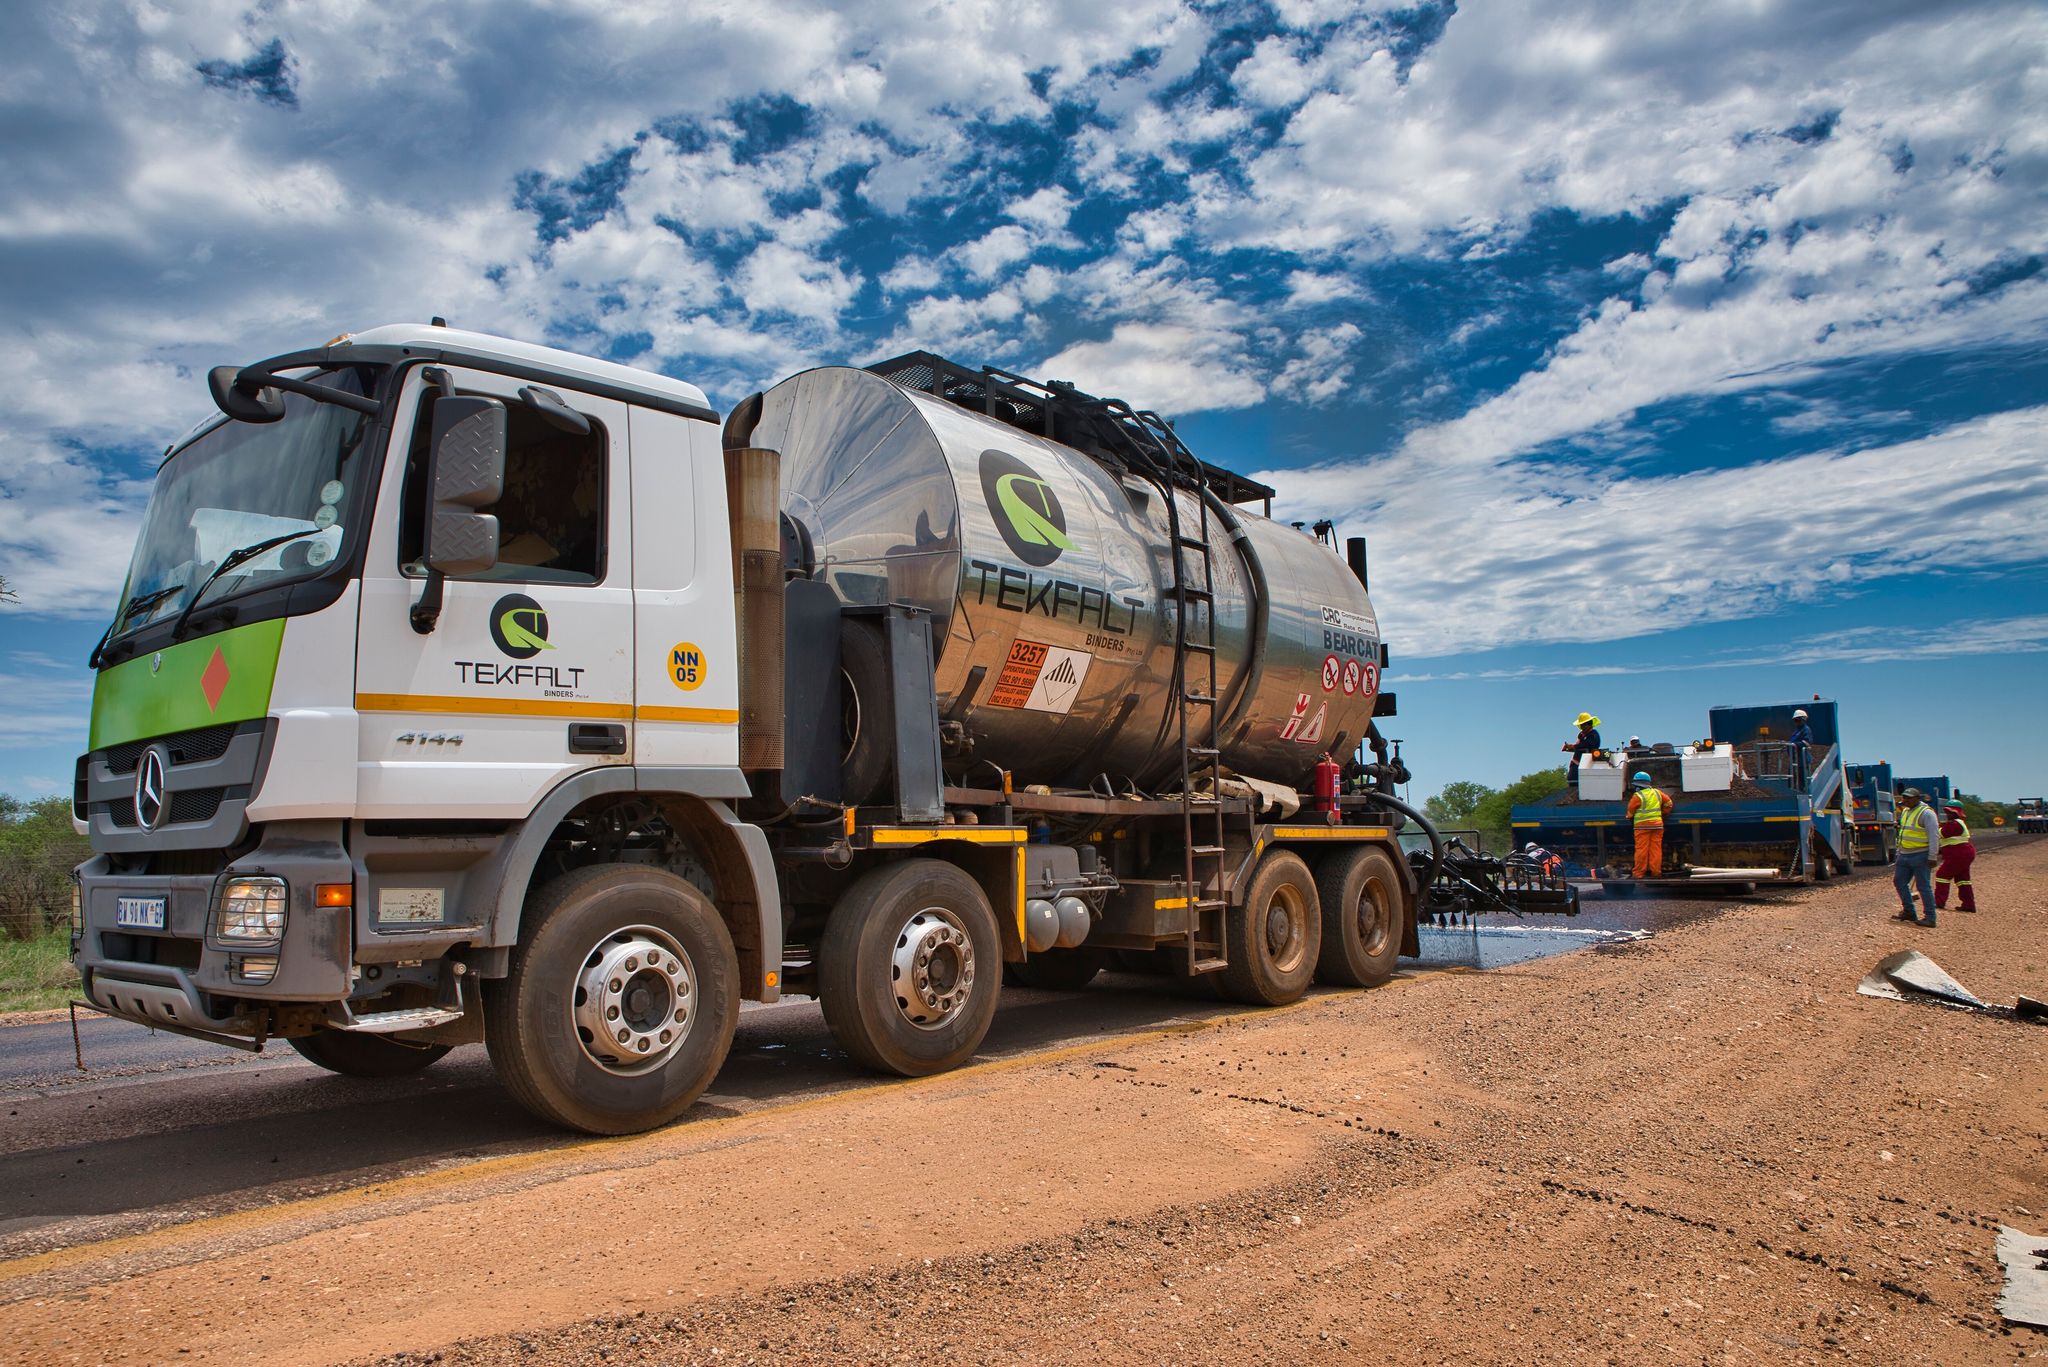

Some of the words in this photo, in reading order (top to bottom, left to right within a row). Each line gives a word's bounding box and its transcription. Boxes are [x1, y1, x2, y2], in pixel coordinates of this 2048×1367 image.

[971, 559, 1145, 637] TEKFALT
[1322, 606, 1341, 625] CRC
[1085, 633, 1125, 652] BINDERS
[1323, 629, 1378, 660] BEARCAT
[673, 650, 699, 667] NN
[1011, 642, 1047, 664] 3257
[454, 661, 585, 689] TEKFALT
[676, 667, 697, 683] 05
[544, 689, 574, 698] BINDERS
[396, 731, 464, 747] 4144
